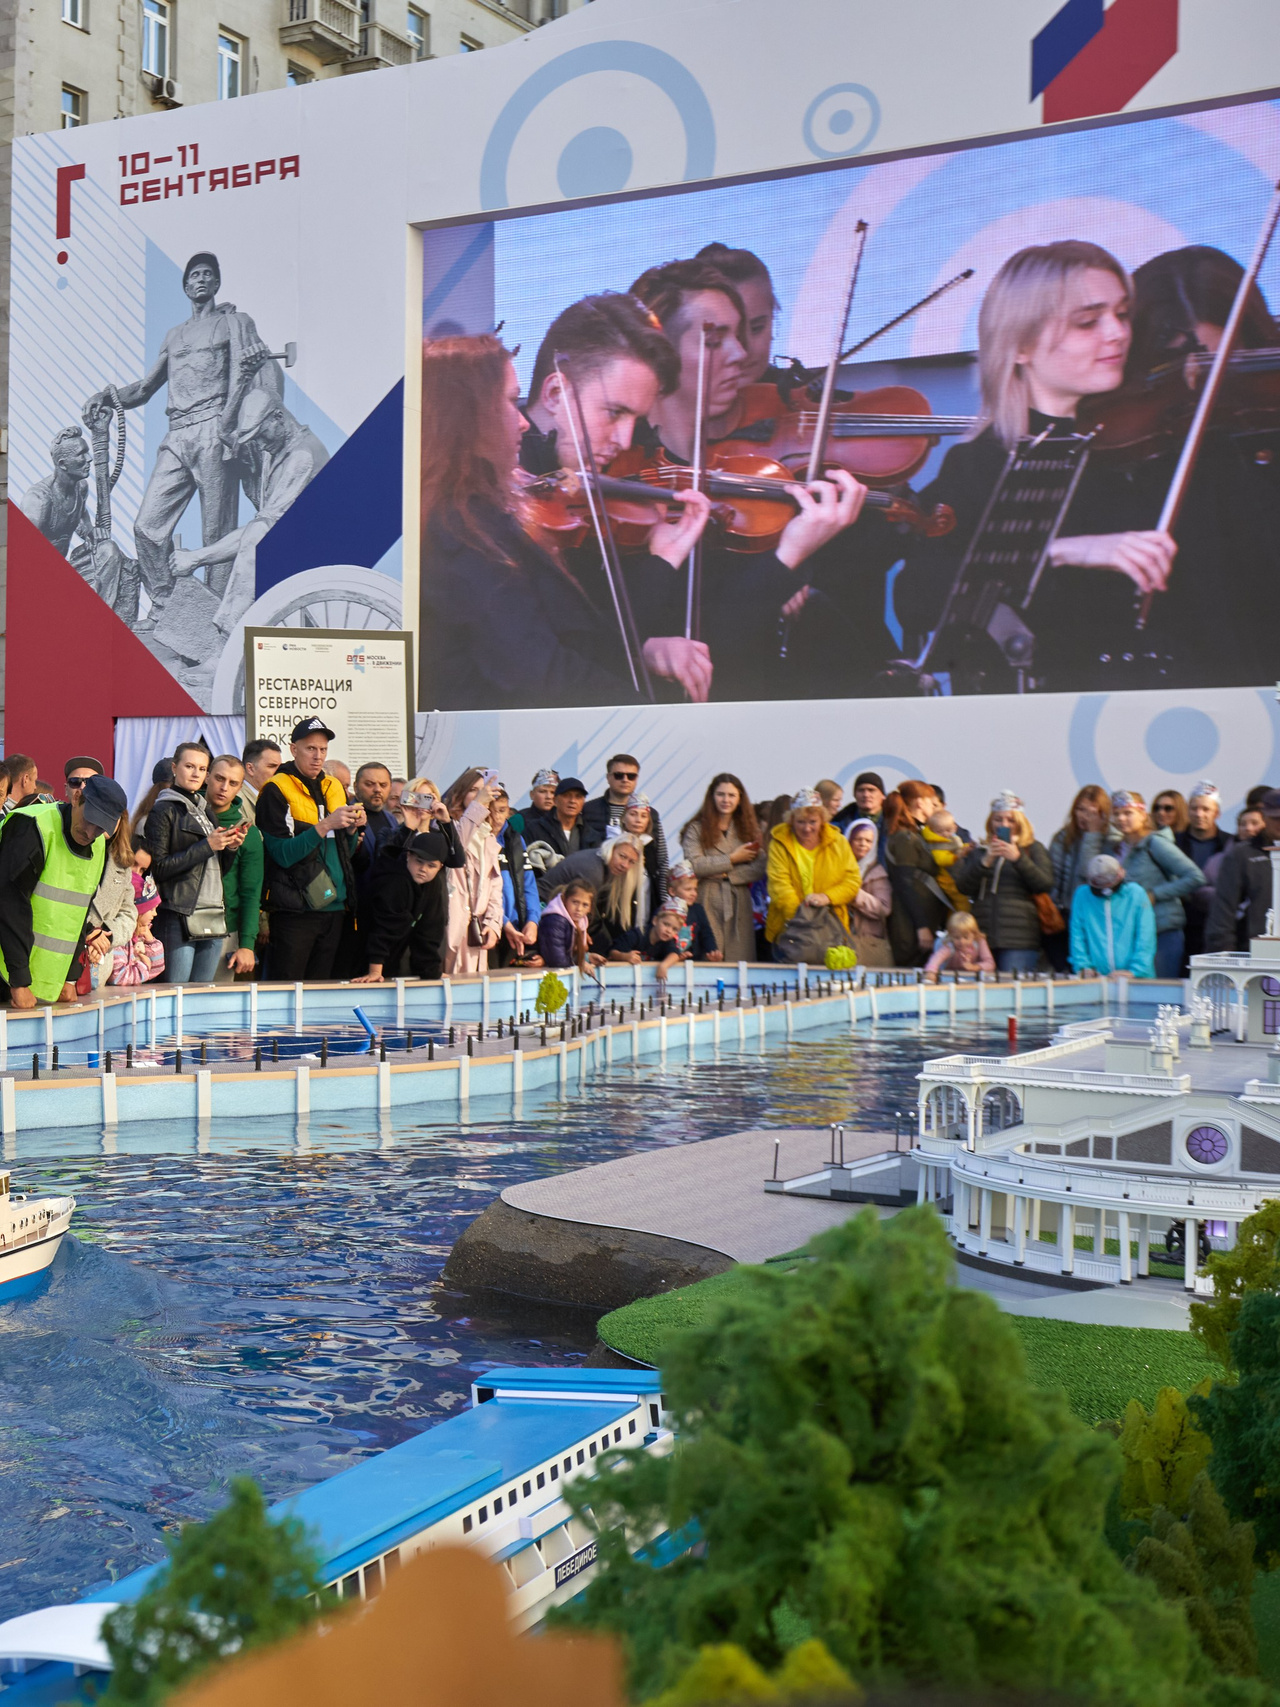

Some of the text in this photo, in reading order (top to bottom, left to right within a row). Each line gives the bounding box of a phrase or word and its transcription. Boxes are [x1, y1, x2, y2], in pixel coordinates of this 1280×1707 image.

[120, 154, 300, 206] СЕНТЯБРЯ
[258, 678, 353, 694] РЕСТАВРАЦИЯ
[258, 696, 338, 710] СЕВЕРНОГО
[259, 715, 320, 728] РЕЧНО
[556, 1543, 598, 1584] ЛЕБЕДИНОЕ
